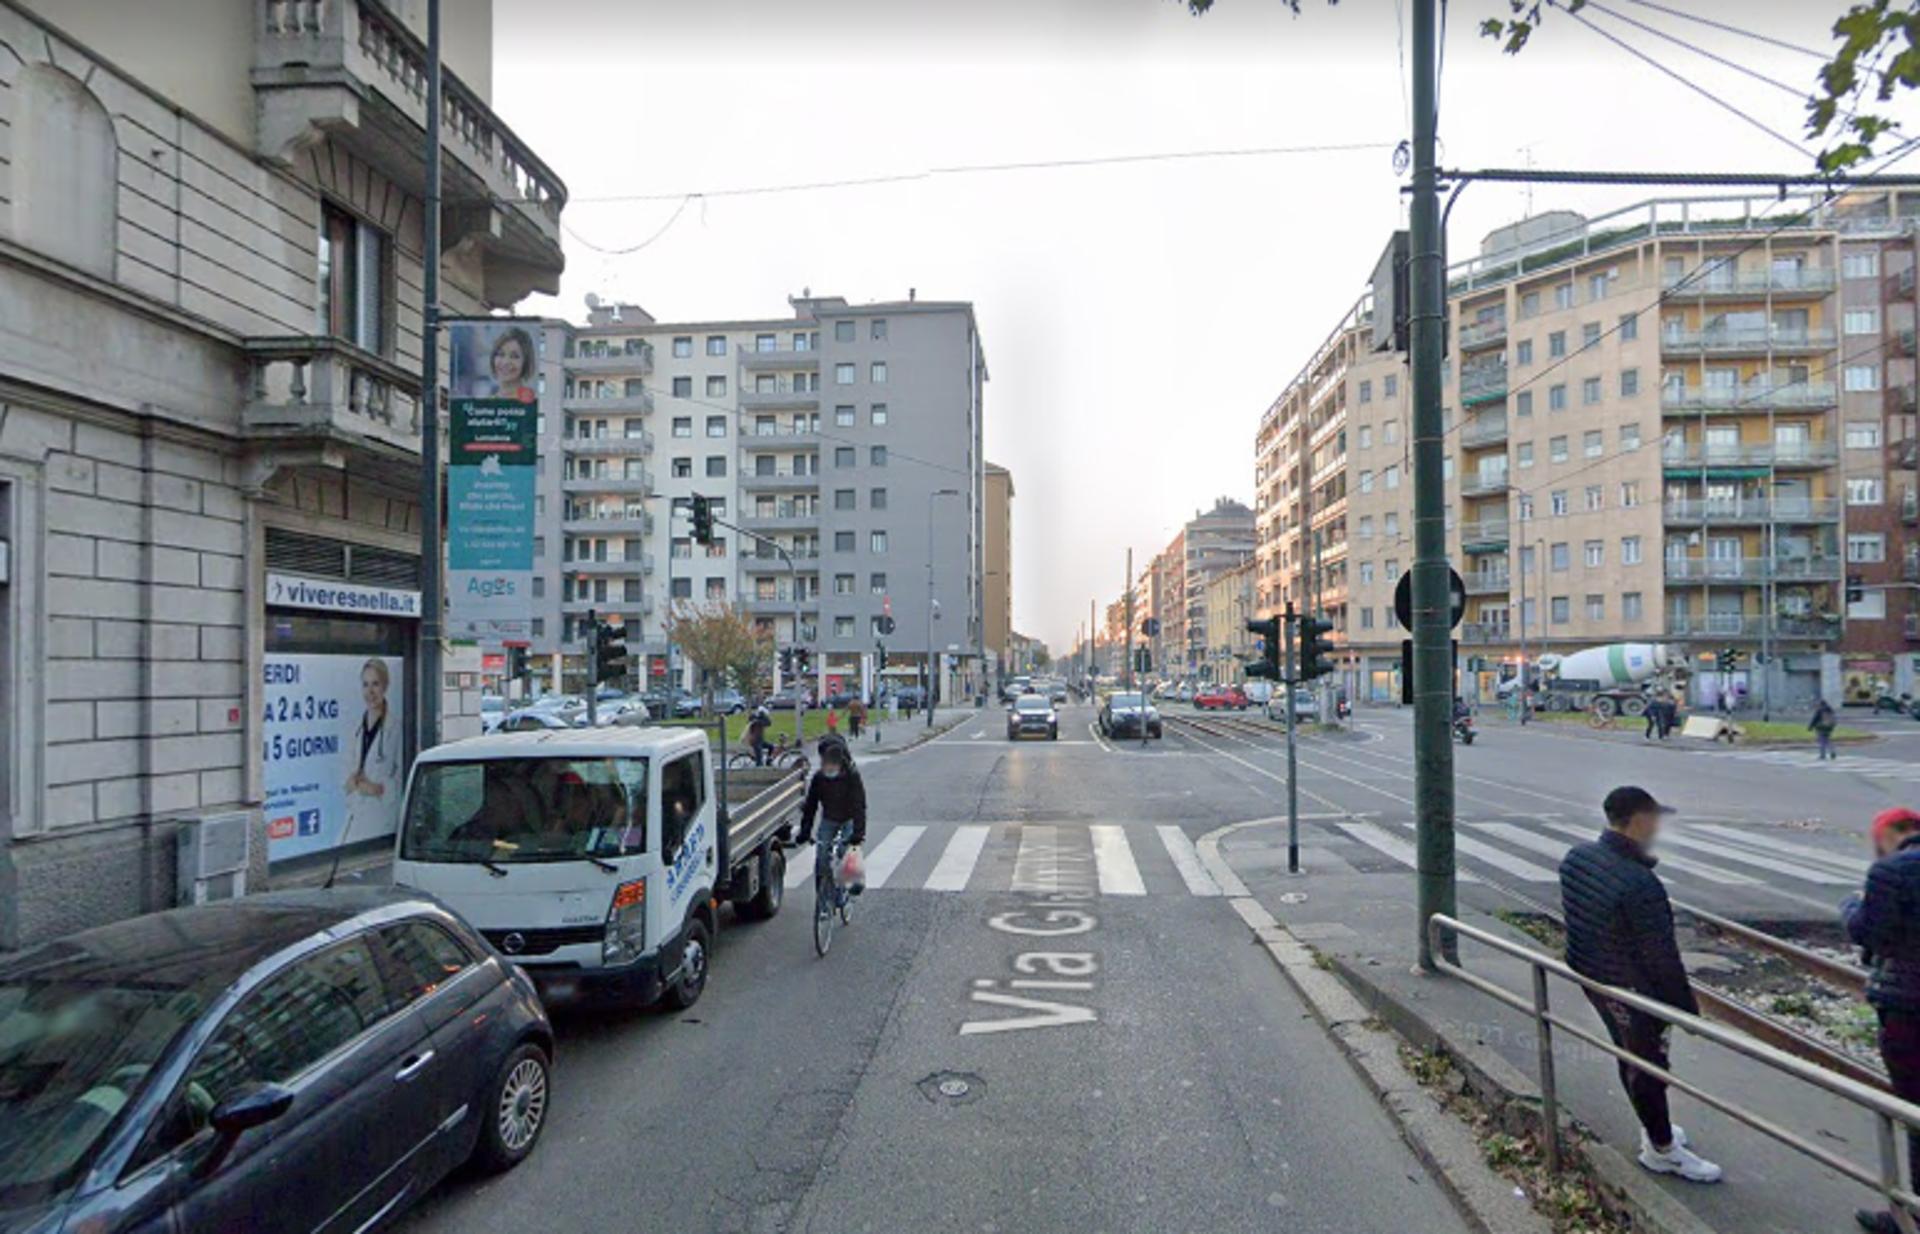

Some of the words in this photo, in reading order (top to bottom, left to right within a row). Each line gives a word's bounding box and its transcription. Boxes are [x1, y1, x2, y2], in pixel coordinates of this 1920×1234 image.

[287, 582, 415, 612] viveresnella.it
[467, 577, 516, 598] Agos
[263, 663, 300, 684] ERDI
[278, 695, 288, 722] 2
[291, 701, 302, 721] A
[305, 695, 315, 721] 3
[318, 699, 339, 720] KG
[273, 734, 283, 760] 5
[286, 735, 340, 759] GIORNI
